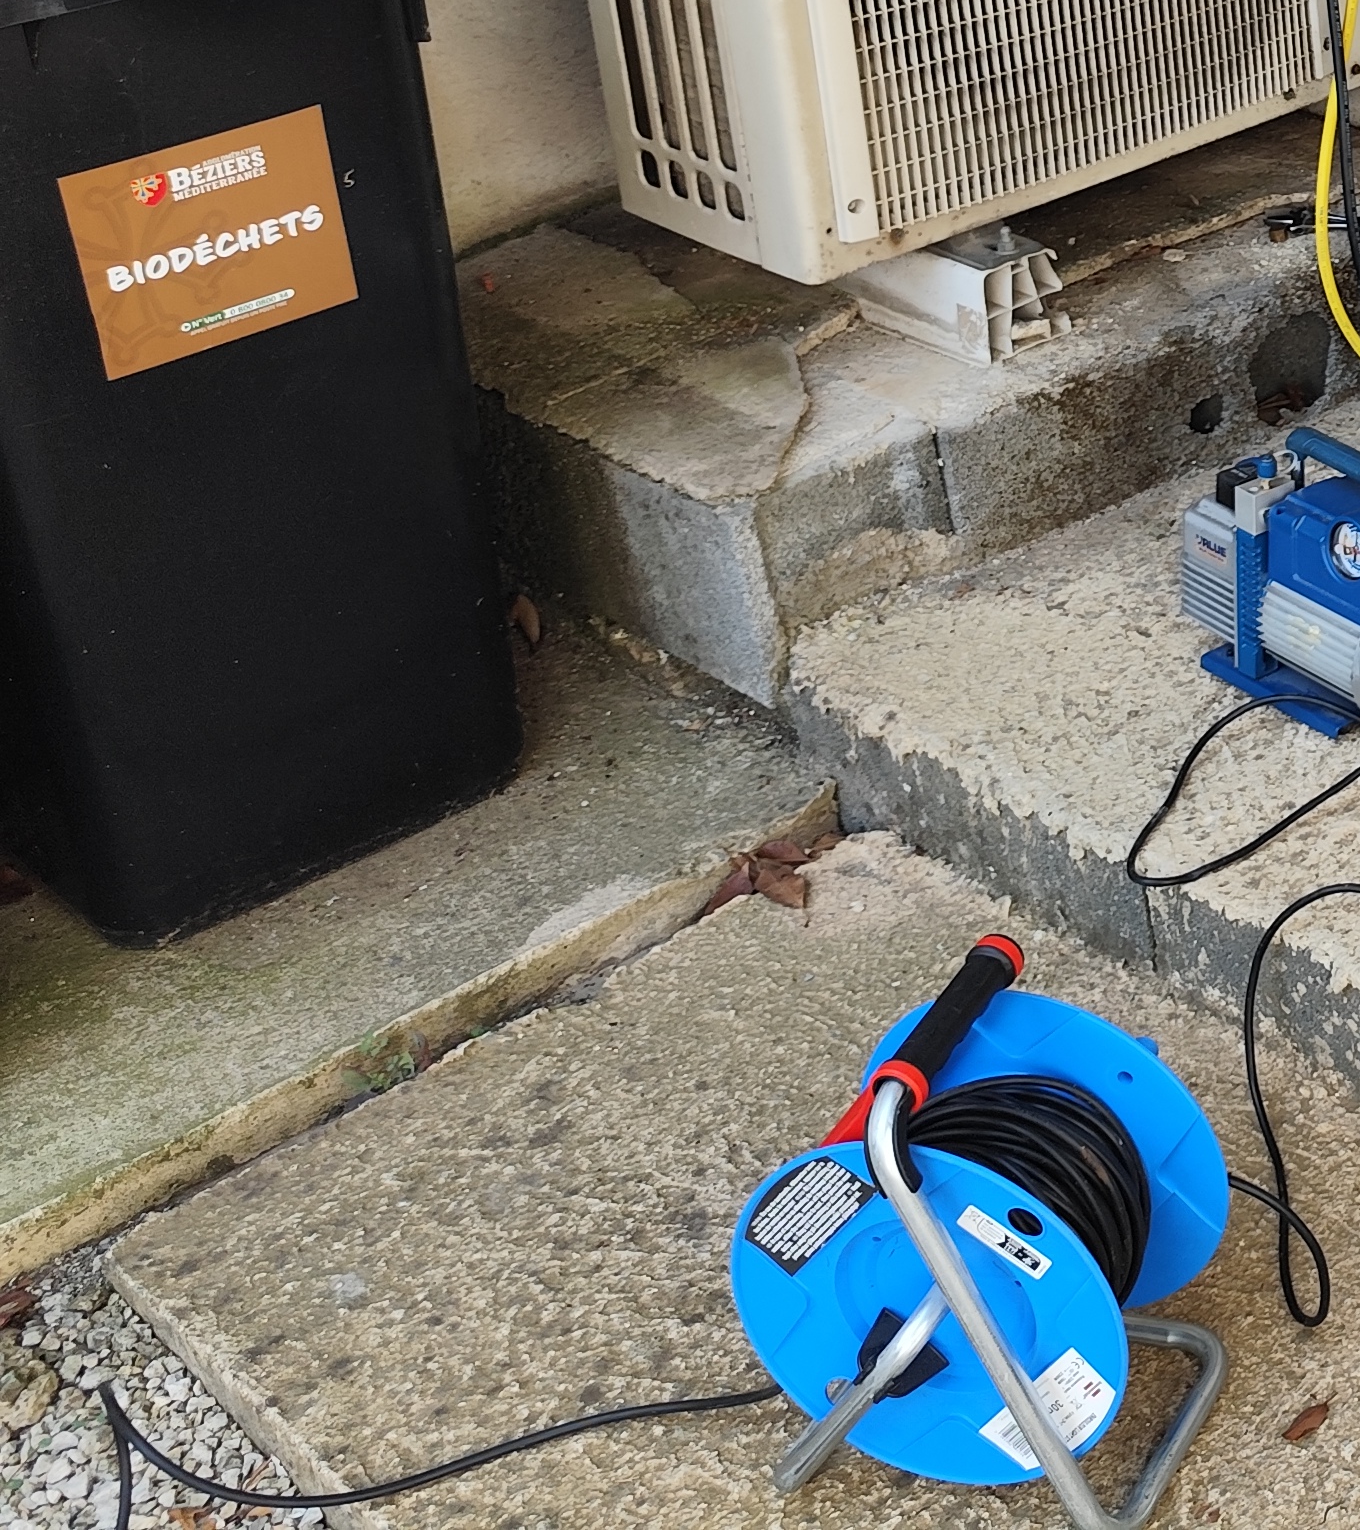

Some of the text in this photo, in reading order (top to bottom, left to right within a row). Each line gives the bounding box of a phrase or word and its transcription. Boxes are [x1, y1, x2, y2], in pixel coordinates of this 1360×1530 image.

[167, 151, 266, 192] BÉZIERS
[172, 166, 268, 202] MÉDITERRANÉE
[106, 204, 324, 292] BIODÉCHETS
[203, 312, 223, 324] Vert
